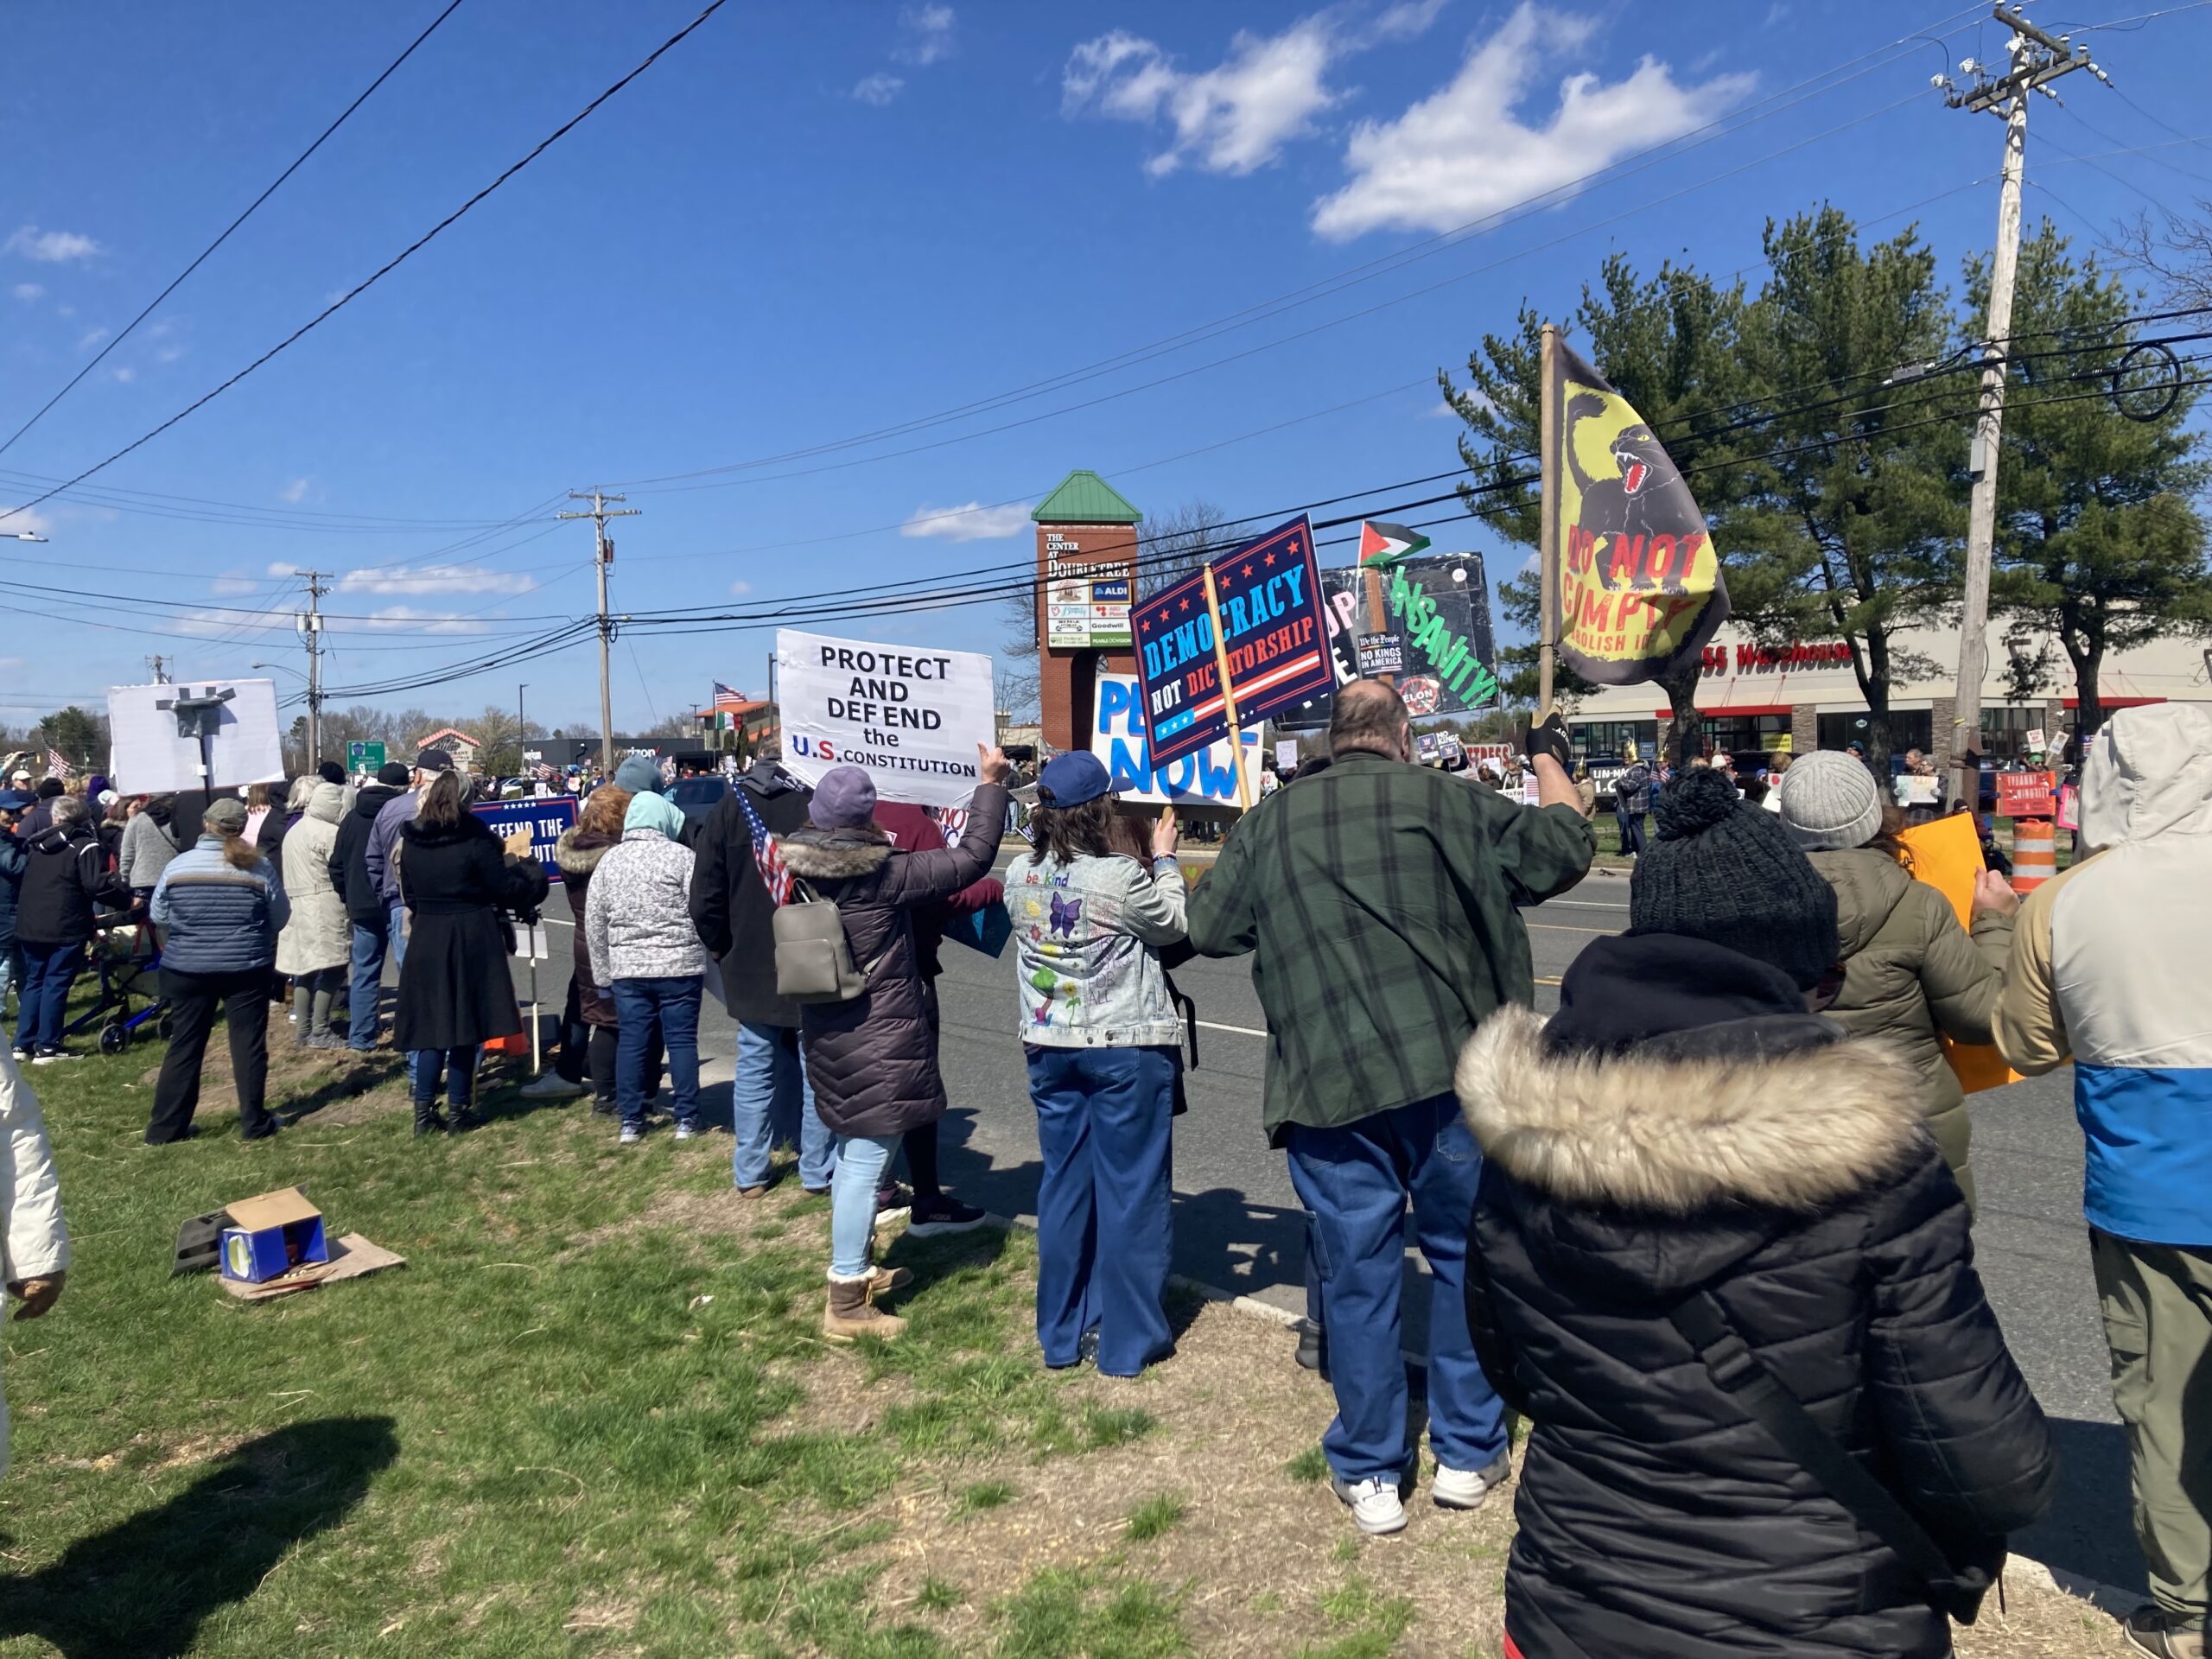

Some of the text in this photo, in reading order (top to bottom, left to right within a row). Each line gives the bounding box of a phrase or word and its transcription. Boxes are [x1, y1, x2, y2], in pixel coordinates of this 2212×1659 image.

[1567, 524, 1707, 578] DO NOT
[1359, 634, 1400, 647] We the People
[1571, 629, 1625, 652] ABOLISH
[821, 646, 950, 679] PROTECT
[1360, 647, 1402, 661] NO KINGS
[1361, 657, 1402, 669] IN AMERICA
[1737, 639, 1853, 666] Waehouse
[1152, 680, 1182, 716] NOT
[1187, 615, 1314, 697] DICATORSHIP
[849, 677, 908, 702] AND
[1402, 689, 1433, 703] ELON
[827, 697, 941, 730] DEFEND
[864, 728, 899, 747] the
[620, 746, 656, 758] erizon
[843, 750, 976, 778] CONSTITUTION
[1111, 738, 1249, 800] NOW
[489, 818, 563, 839] EFEND THE
[1026, 870, 1070, 887] be kind
[1090, 989, 1114, 1006] ALL
